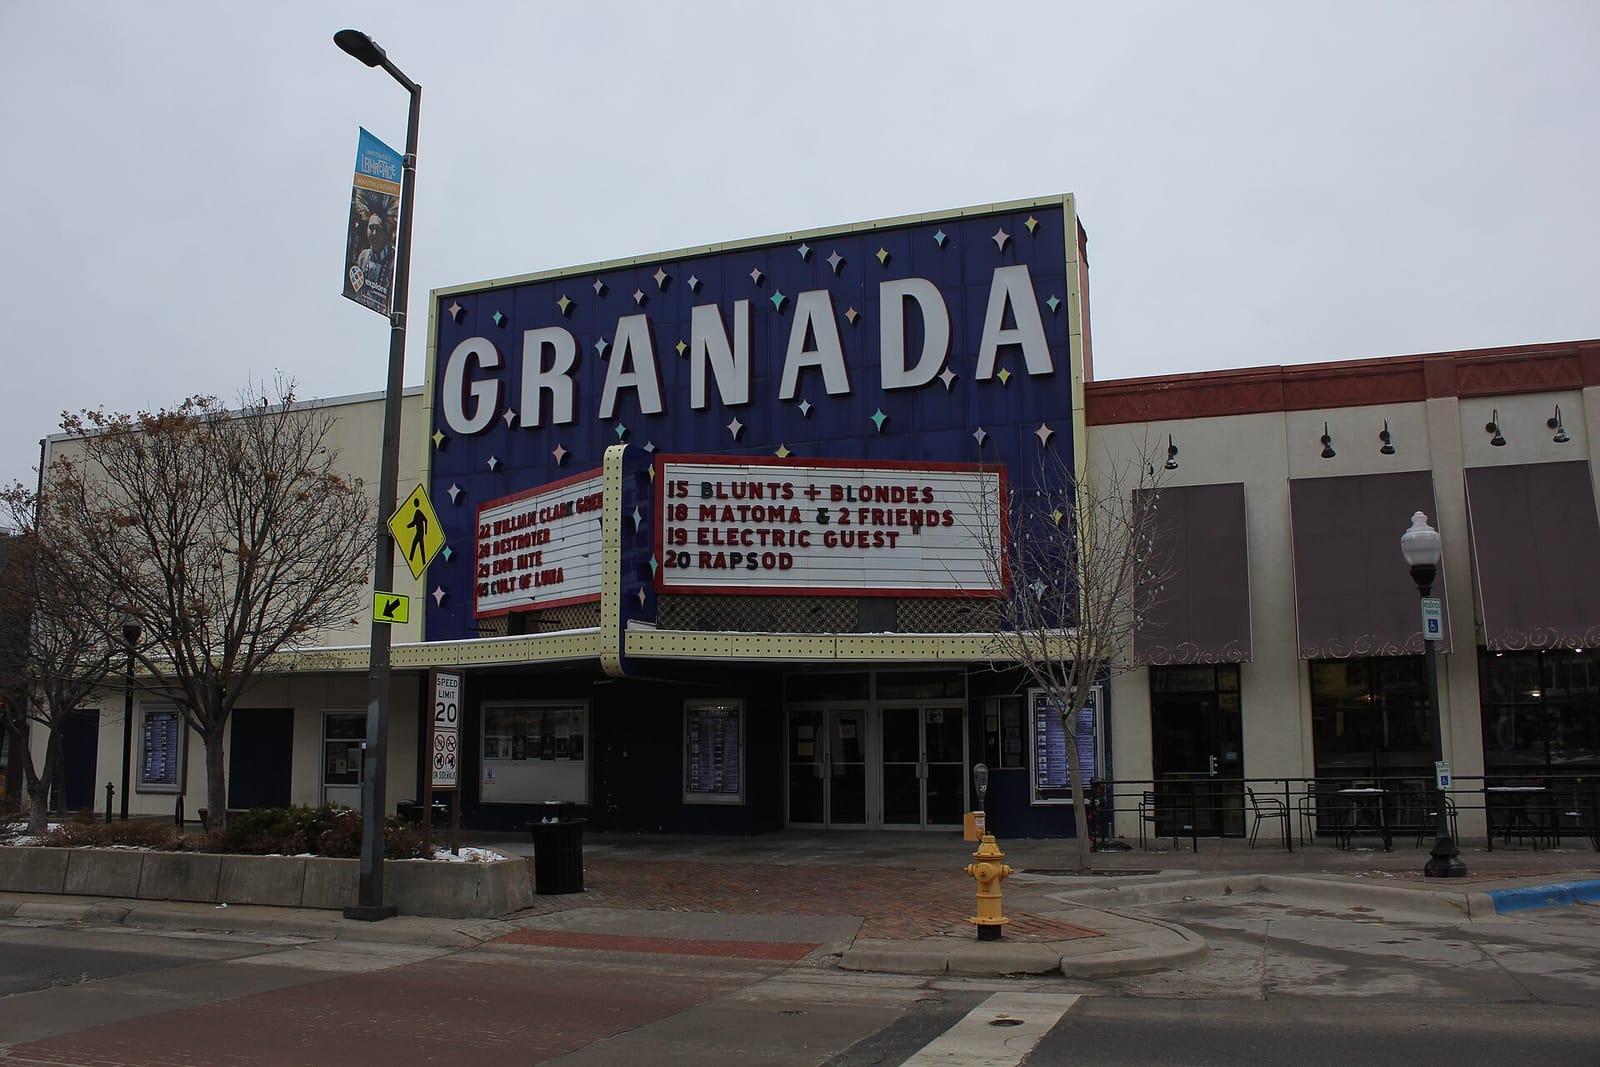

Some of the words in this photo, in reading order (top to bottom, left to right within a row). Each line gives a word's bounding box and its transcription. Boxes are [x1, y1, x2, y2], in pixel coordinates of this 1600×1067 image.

[442, 264, 1054, 435] GRANADA
[668, 480, 689, 499] 15
[701, 481, 794, 500] BLUNTS
[804, 484, 821, 501] +
[831, 484, 935, 504] BLONDES
[479, 523, 491, 539] 22
[493, 510, 537, 536] WILLIAM
[539, 500, 574, 523] CLARK
[668, 504, 688, 521] 18
[700, 504, 802, 524] MATOMA
[816, 507, 830, 525] &
[838, 508, 851, 525] 2
[858, 508, 954, 527] FRIENDS
[493, 528, 551, 556] DESTROYER
[667, 527, 688, 545] 19
[697, 528, 811, 548] ELECTRIC
[823, 530, 900, 549] GUEST
[493, 556, 514, 575] EMO
[517, 550, 543, 570] NITE
[664, 550, 691, 569] 20
[699, 551, 794, 571] RAPSOD
[491, 576, 516, 594] CULT
[519, 573, 532, 589] OF
[534, 567, 564, 587] LUNA
[437, 677, 458, 688] SPEED
[438, 690, 456, 700] LIMIT
[435, 702, 457, 722] 20
